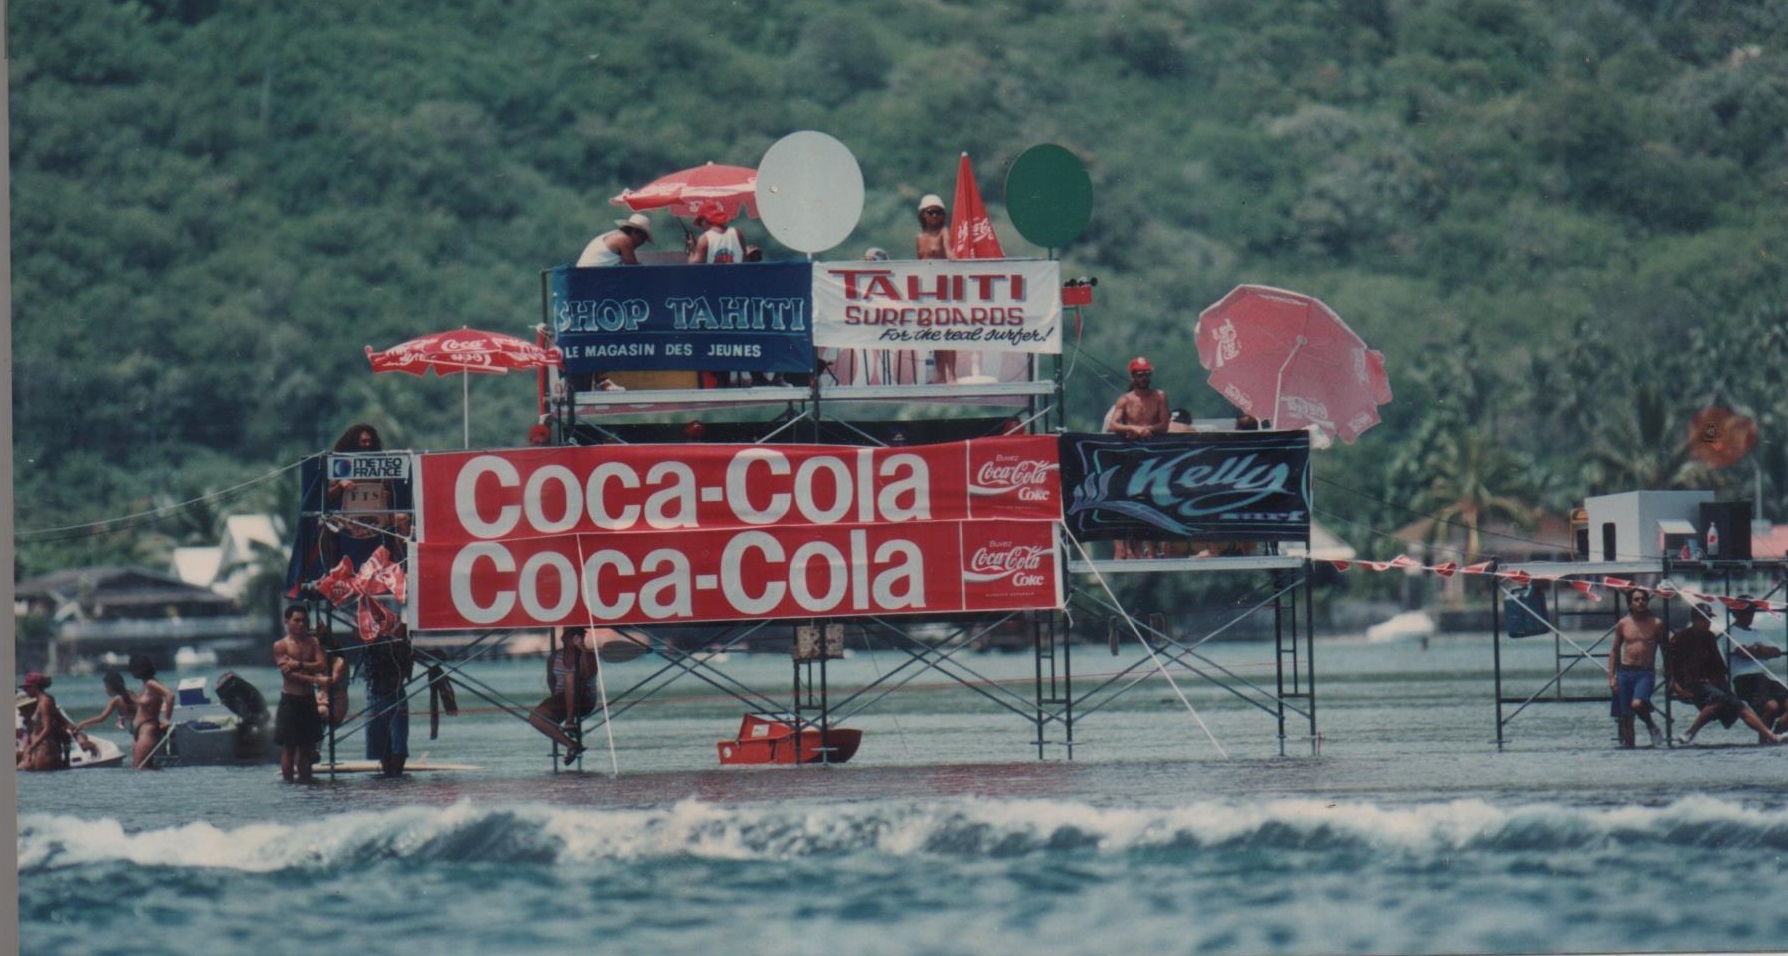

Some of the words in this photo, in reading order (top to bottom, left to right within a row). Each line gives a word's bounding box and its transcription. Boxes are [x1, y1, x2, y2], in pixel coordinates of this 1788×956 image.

[827, 269, 1027, 302] TAHITI
[553, 298, 650, 332] SHOP
[665, 297, 805, 331] TAHITI
[844, 305, 1025, 327] SURFBOARDS
[878, 327, 911, 341] For
[914, 327, 941, 341] the
[944, 326, 982, 341] real
[984, 326, 1055, 346] surfer!
[565, 345, 579, 359] LE
[585, 344, 655, 358] MAGASIN
[665, 343, 693, 356] DES
[707, 343, 761, 358] JEUNES
[977, 460, 1049, 486] Coca-Cola
[1126, 446, 1296, 516] Kelly
[455, 447, 932, 539] Coca-Cola
[1018, 487, 1051, 501] Coke
[971, 545, 1043, 572] Coca-Cola
[450, 528, 927, 624] Coca-Cola
[1012, 572, 1045, 587] Coke
